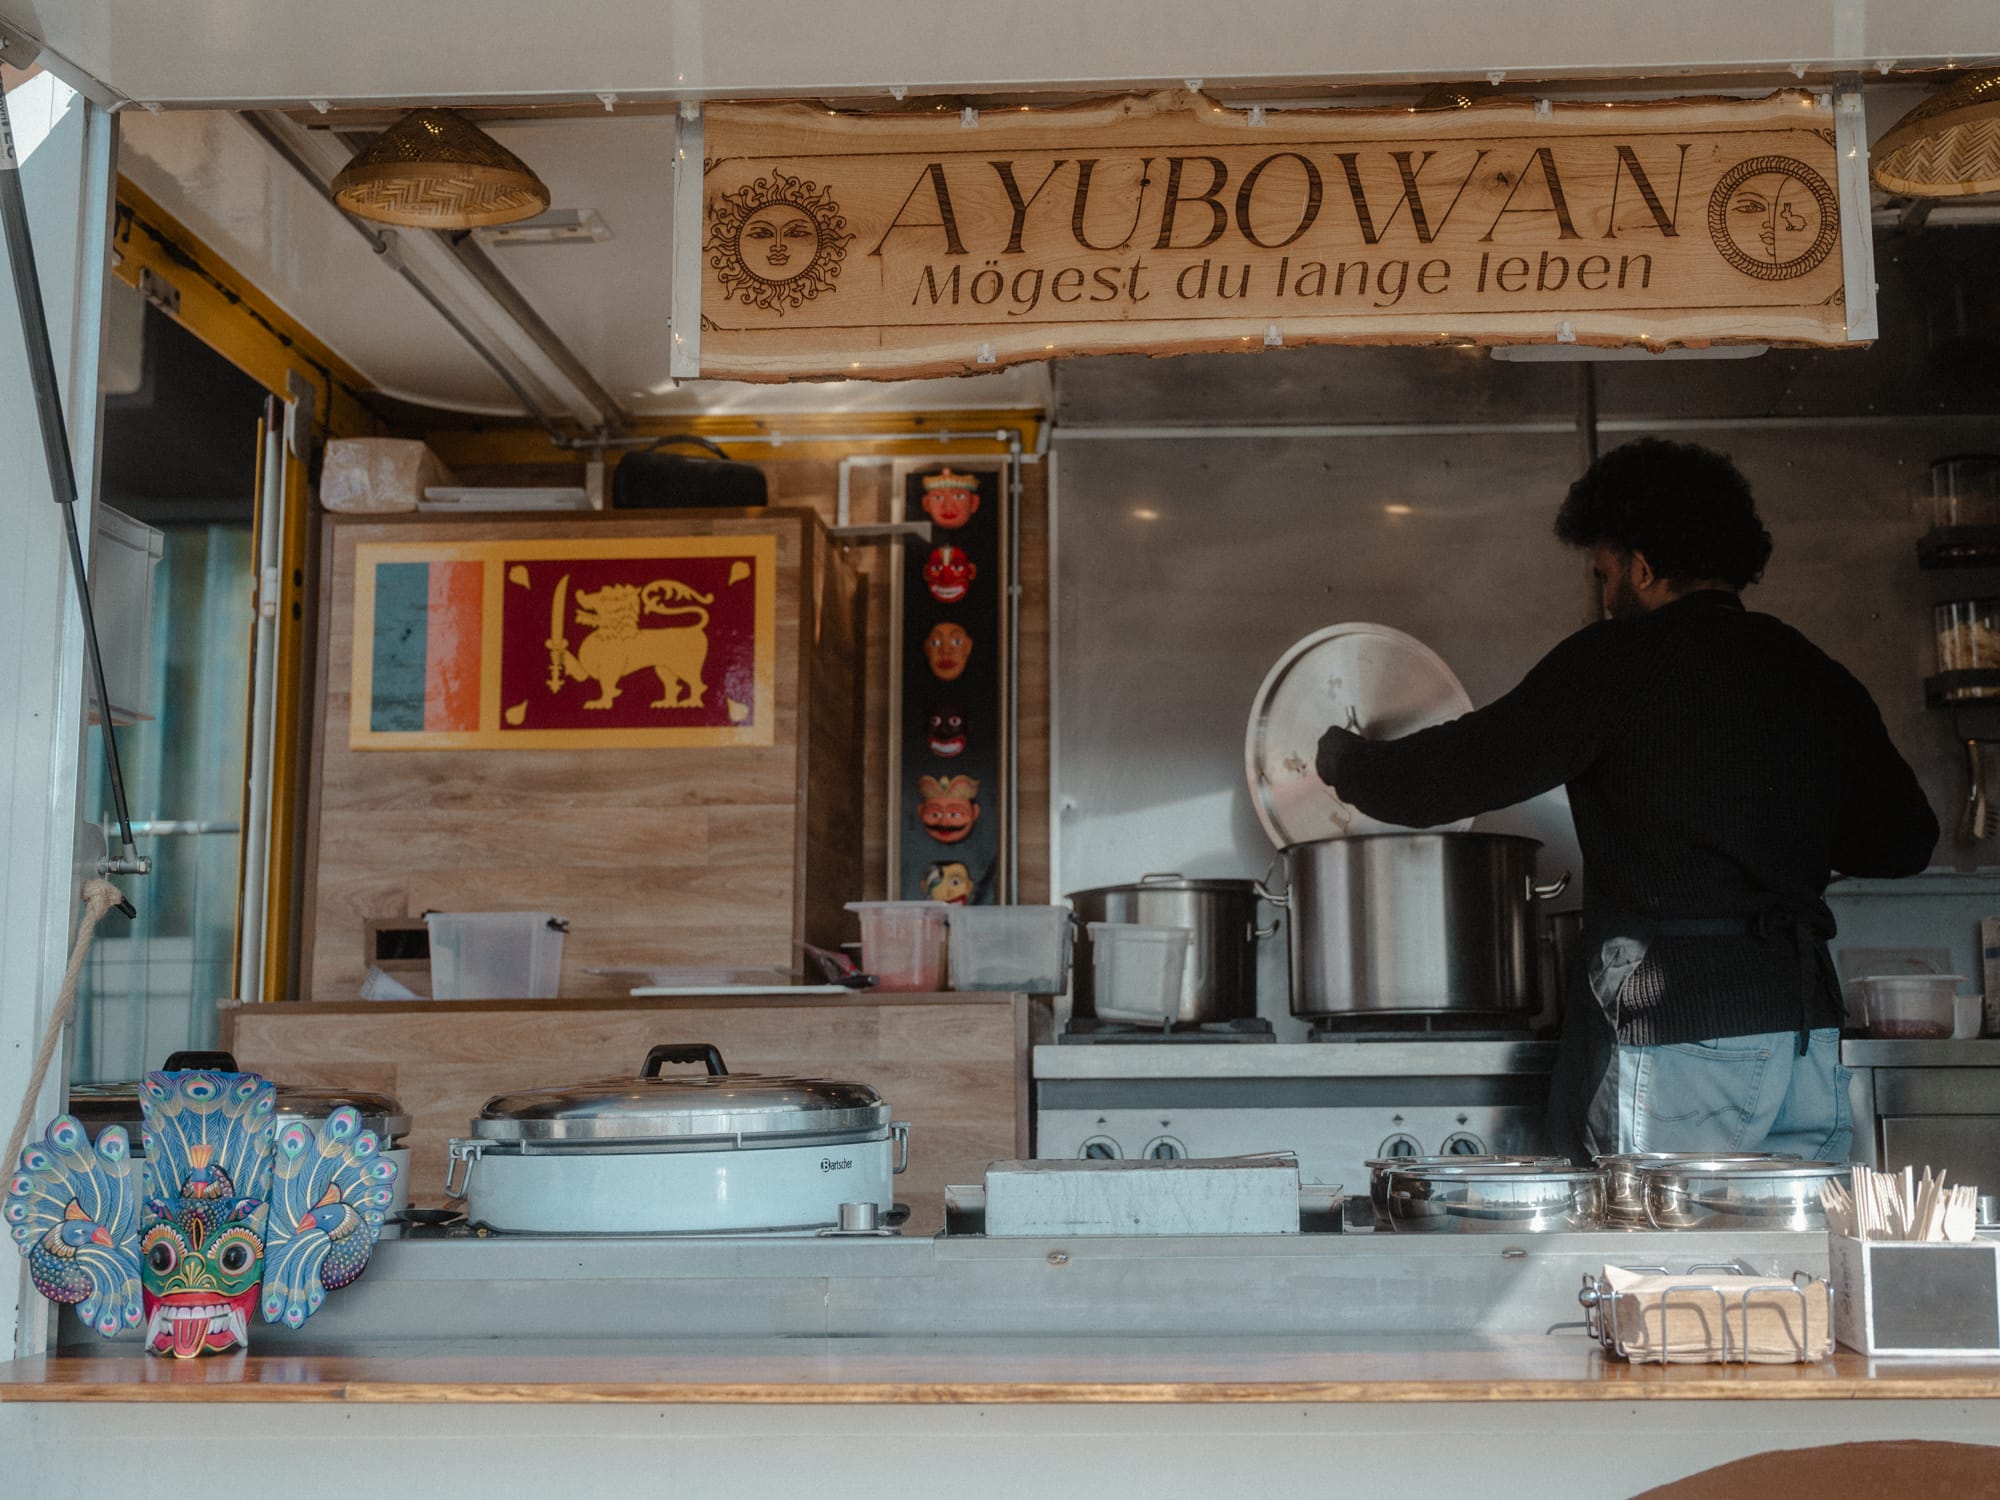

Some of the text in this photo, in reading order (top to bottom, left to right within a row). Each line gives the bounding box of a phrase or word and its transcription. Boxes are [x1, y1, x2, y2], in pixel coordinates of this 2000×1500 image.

[867, 143, 1691, 256] AYUBOWAN
[911, 250, 1653, 316] Mögest du lange leben
[820, 1157, 853, 1173] Bartscher
